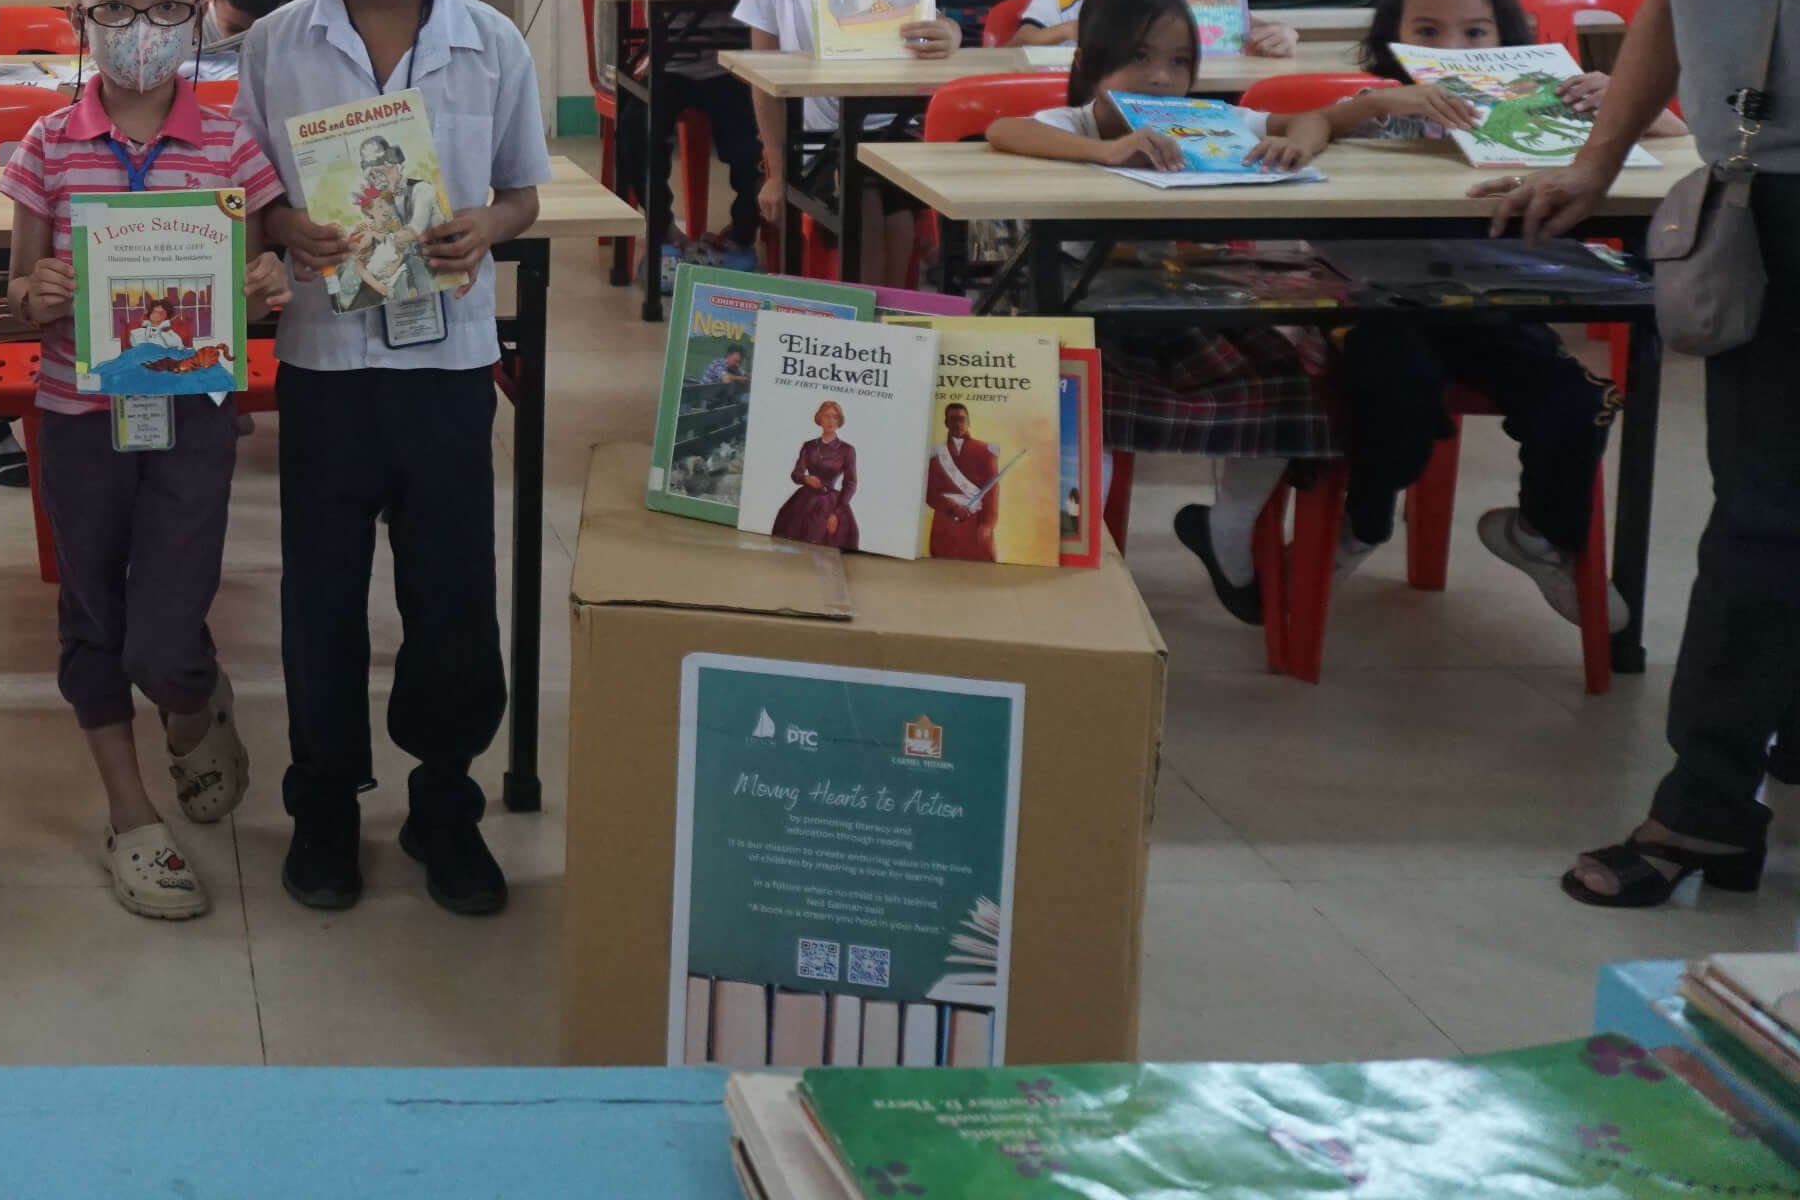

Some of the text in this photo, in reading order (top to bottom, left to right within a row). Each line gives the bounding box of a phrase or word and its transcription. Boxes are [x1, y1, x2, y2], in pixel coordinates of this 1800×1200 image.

[299, 120, 327, 138] GUS
[328, 120, 345, 131] and
[345, 100, 411, 127] GRANDPA
[93, 217, 228, 245] I Love Saturday
[693, 311, 744, 341] New
[779, 333, 892, 365] Elizabeth
[938, 351, 1016, 369] ussaint
[781, 355, 890, 388] Blackwell
[937, 373, 1032, 391] uverture
[775, 377, 895, 400] THE FIRST WOMAN DOCTOR
[966, 394, 1009, 403] LIBERTY
[786, 728, 819, 746] DTC
[734, 772, 964, 818] Moving Hearts to Action
[802, 815, 851, 829] promoting
[836, 831, 875, 845] through
